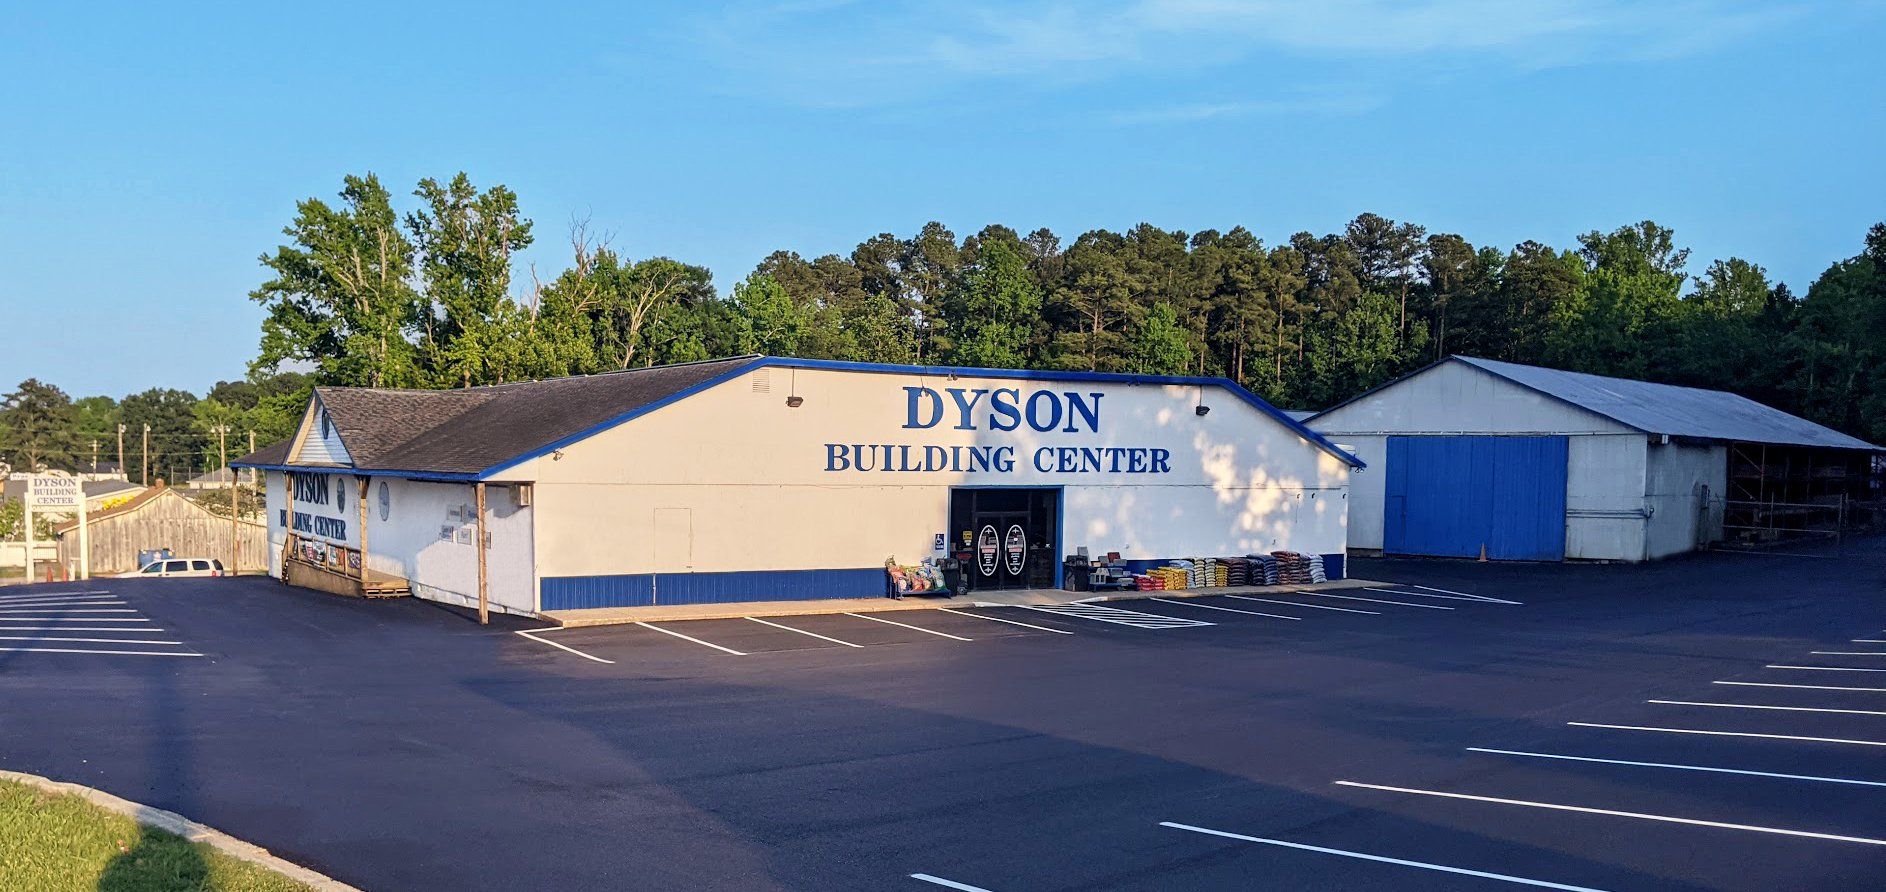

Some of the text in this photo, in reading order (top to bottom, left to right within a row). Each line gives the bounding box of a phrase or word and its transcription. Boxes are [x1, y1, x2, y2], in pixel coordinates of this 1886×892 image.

[902, 387, 1104, 433] DYSON
[824, 444, 1171, 473] BUILDING CENTER
[34, 478, 77, 487] DYSON
[34, 488, 77, 496] BUILDING
[293, 472, 329, 505] DYSON
[314, 515, 347, 540] CENTER
